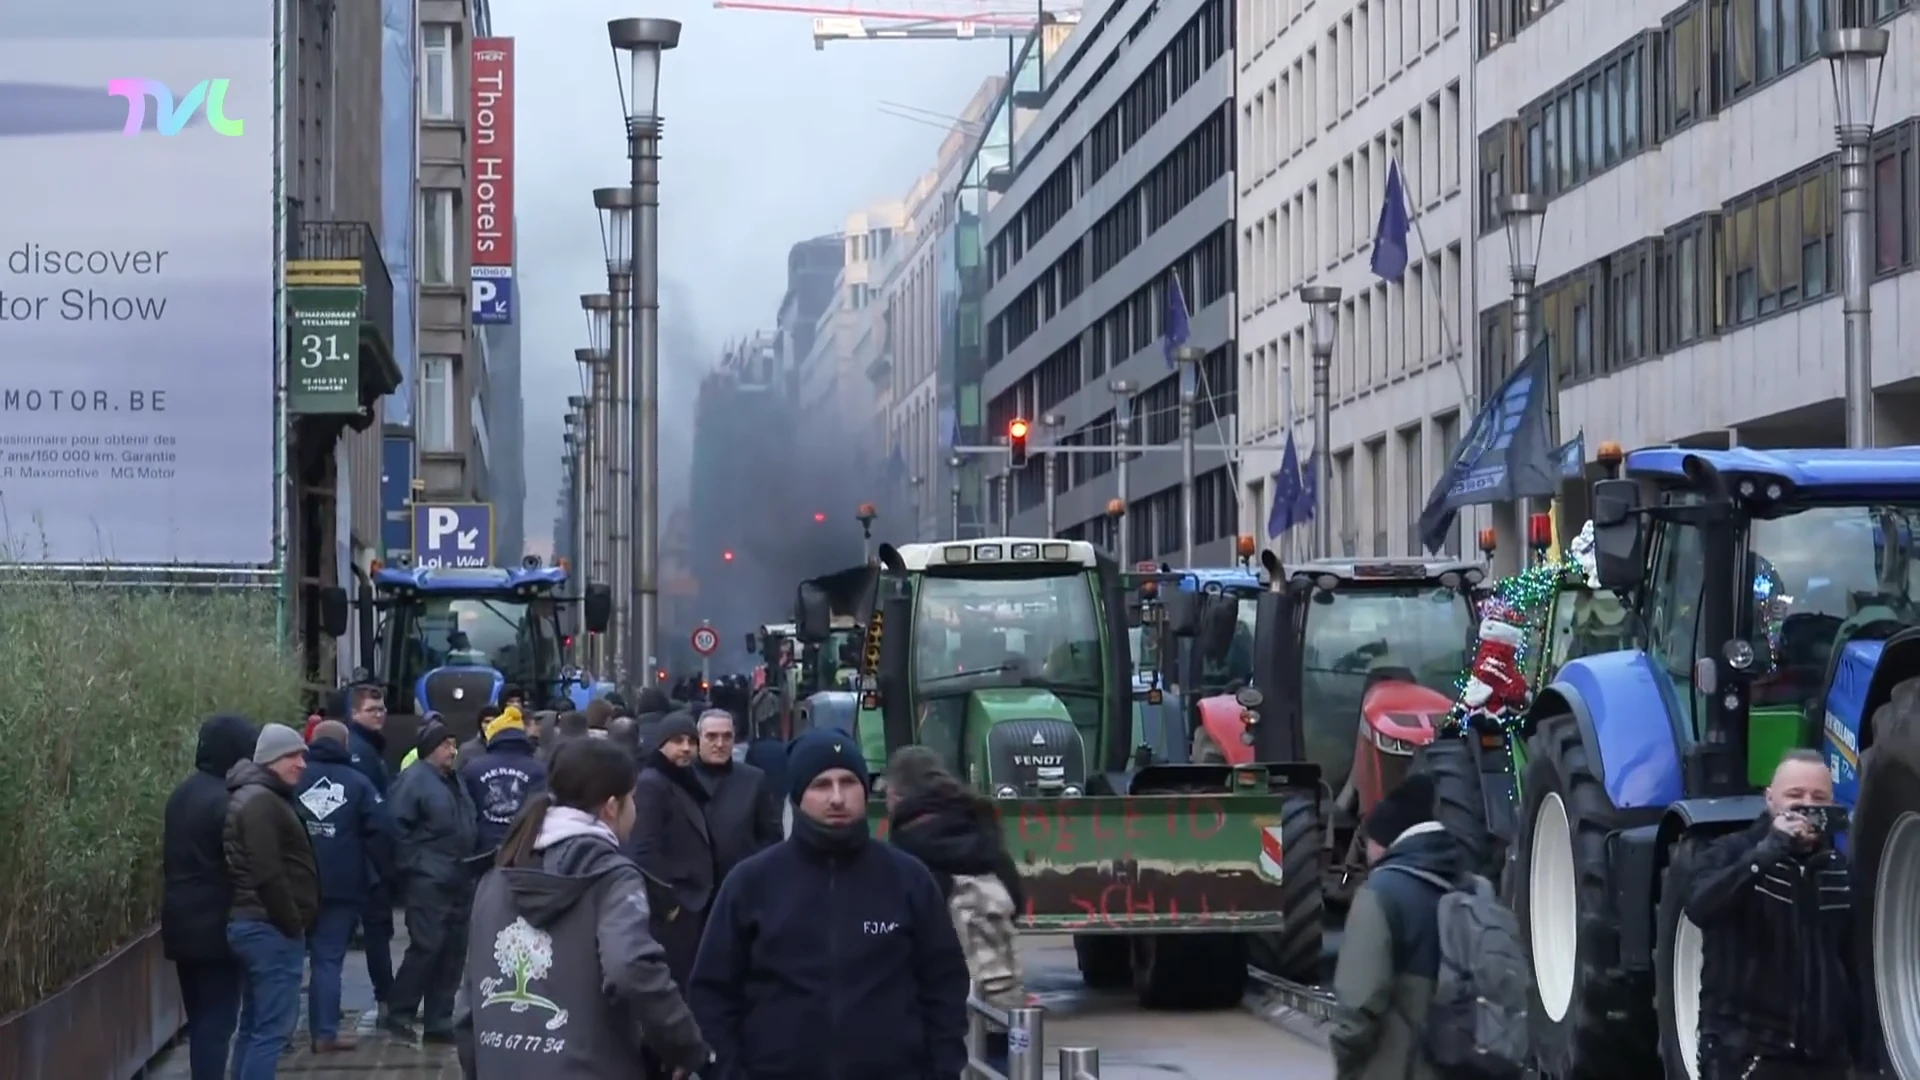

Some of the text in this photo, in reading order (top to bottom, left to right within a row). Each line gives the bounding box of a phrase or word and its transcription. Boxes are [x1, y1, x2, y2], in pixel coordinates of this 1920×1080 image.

[477, 70, 502, 251] Thon Hotels
[9, 243, 168, 274] discover
[61, 289, 166, 320] Show
[473, 281, 496, 311] P
[301, 334, 350, 368] 31.
[5, 390, 166, 411] MOTOR.BE
[71, 436, 99, 447] pour
[105, 433, 148, 445] obtenir
[154, 433, 176, 445] des
[62, 450, 90, 462] 000
[121, 450, 176, 462] Garantie
[111, 467, 134, 478] MG
[138, 467, 175, 478] Motor
[428, 507, 459, 549] P
[1014, 754, 1064, 765] FENDT
[505, 1034, 522, 1050] 67
[525, 1035, 541, 1051] 77
[543, 1037, 565, 1053] 34
